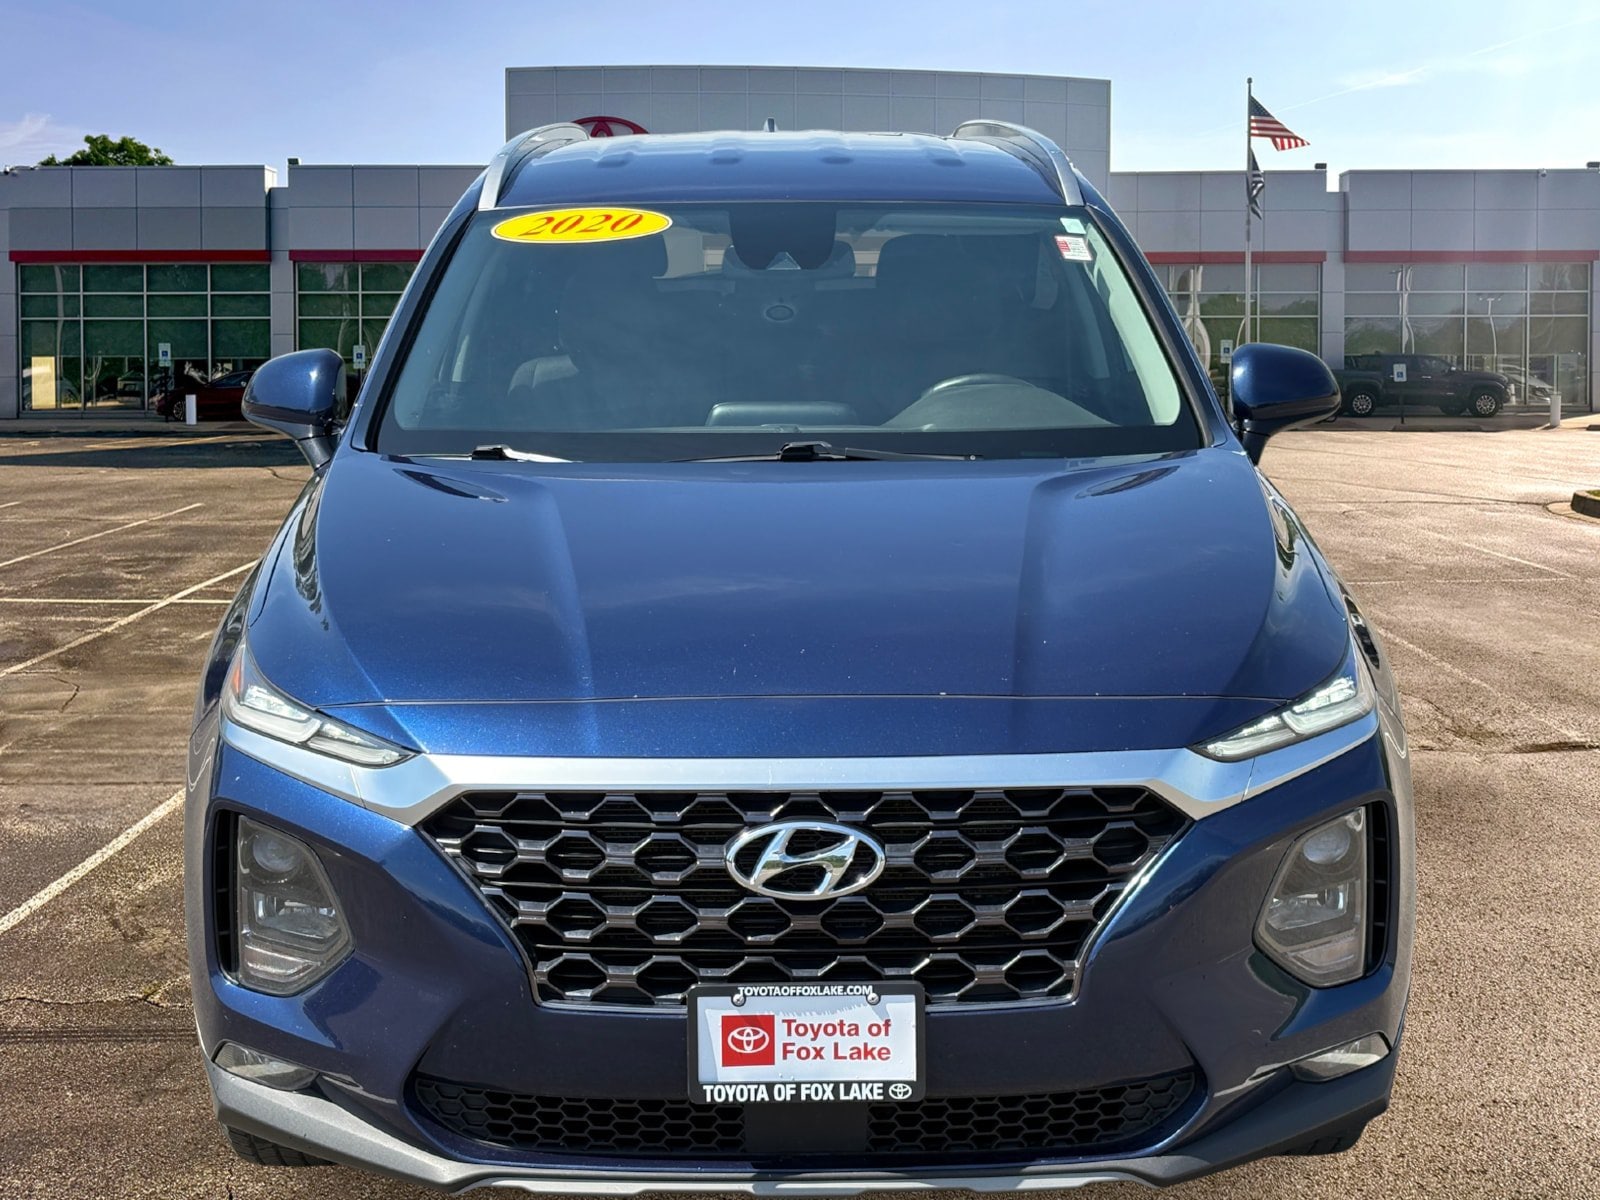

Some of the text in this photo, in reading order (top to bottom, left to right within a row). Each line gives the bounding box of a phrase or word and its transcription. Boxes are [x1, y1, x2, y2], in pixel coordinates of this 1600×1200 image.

[518, 213, 644, 237] 2020
[737, 985, 874, 997] TOYOTAOFFOXLAKE.COM
[781, 1018, 892, 1041] Toyota of
[781, 1042, 892, 1061] Fox Lake
[703, 1082, 884, 1102] TOYOTA OF FOX LAKE
